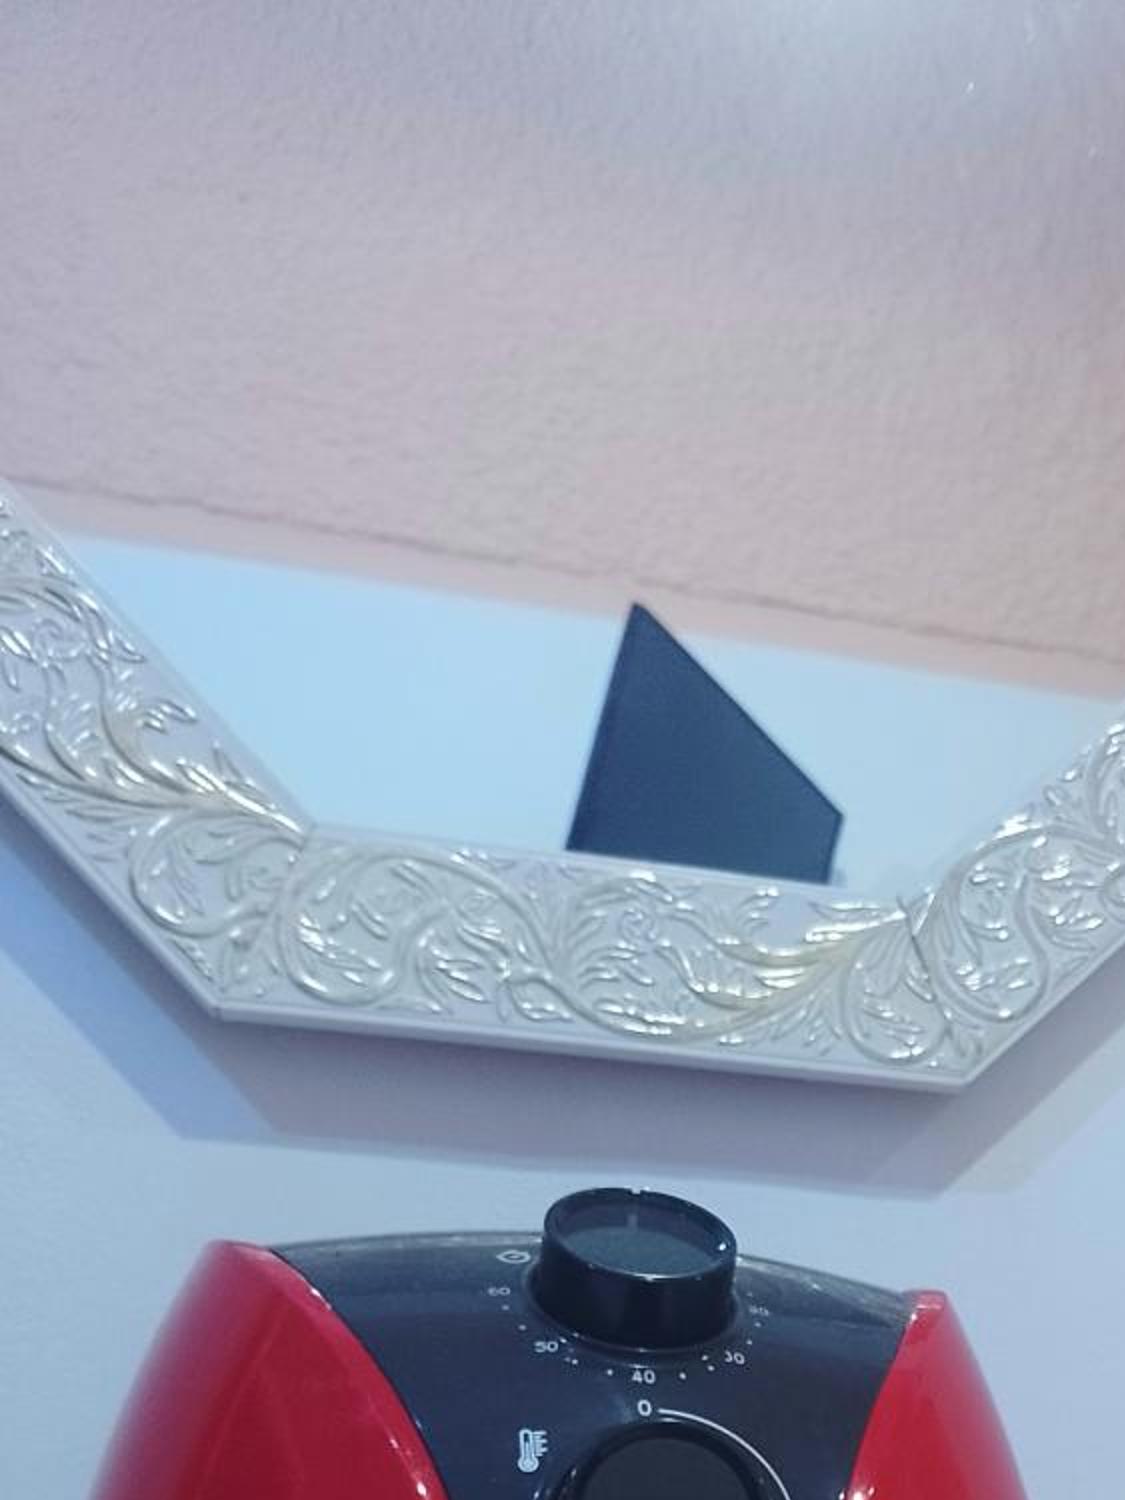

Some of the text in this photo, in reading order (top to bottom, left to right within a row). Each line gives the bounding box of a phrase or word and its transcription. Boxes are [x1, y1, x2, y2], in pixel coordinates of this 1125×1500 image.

[725, 1350, 746, 1365] 30
[631, 1369, 656, 1384] 40
[637, 1399, 652, 1417] 0
